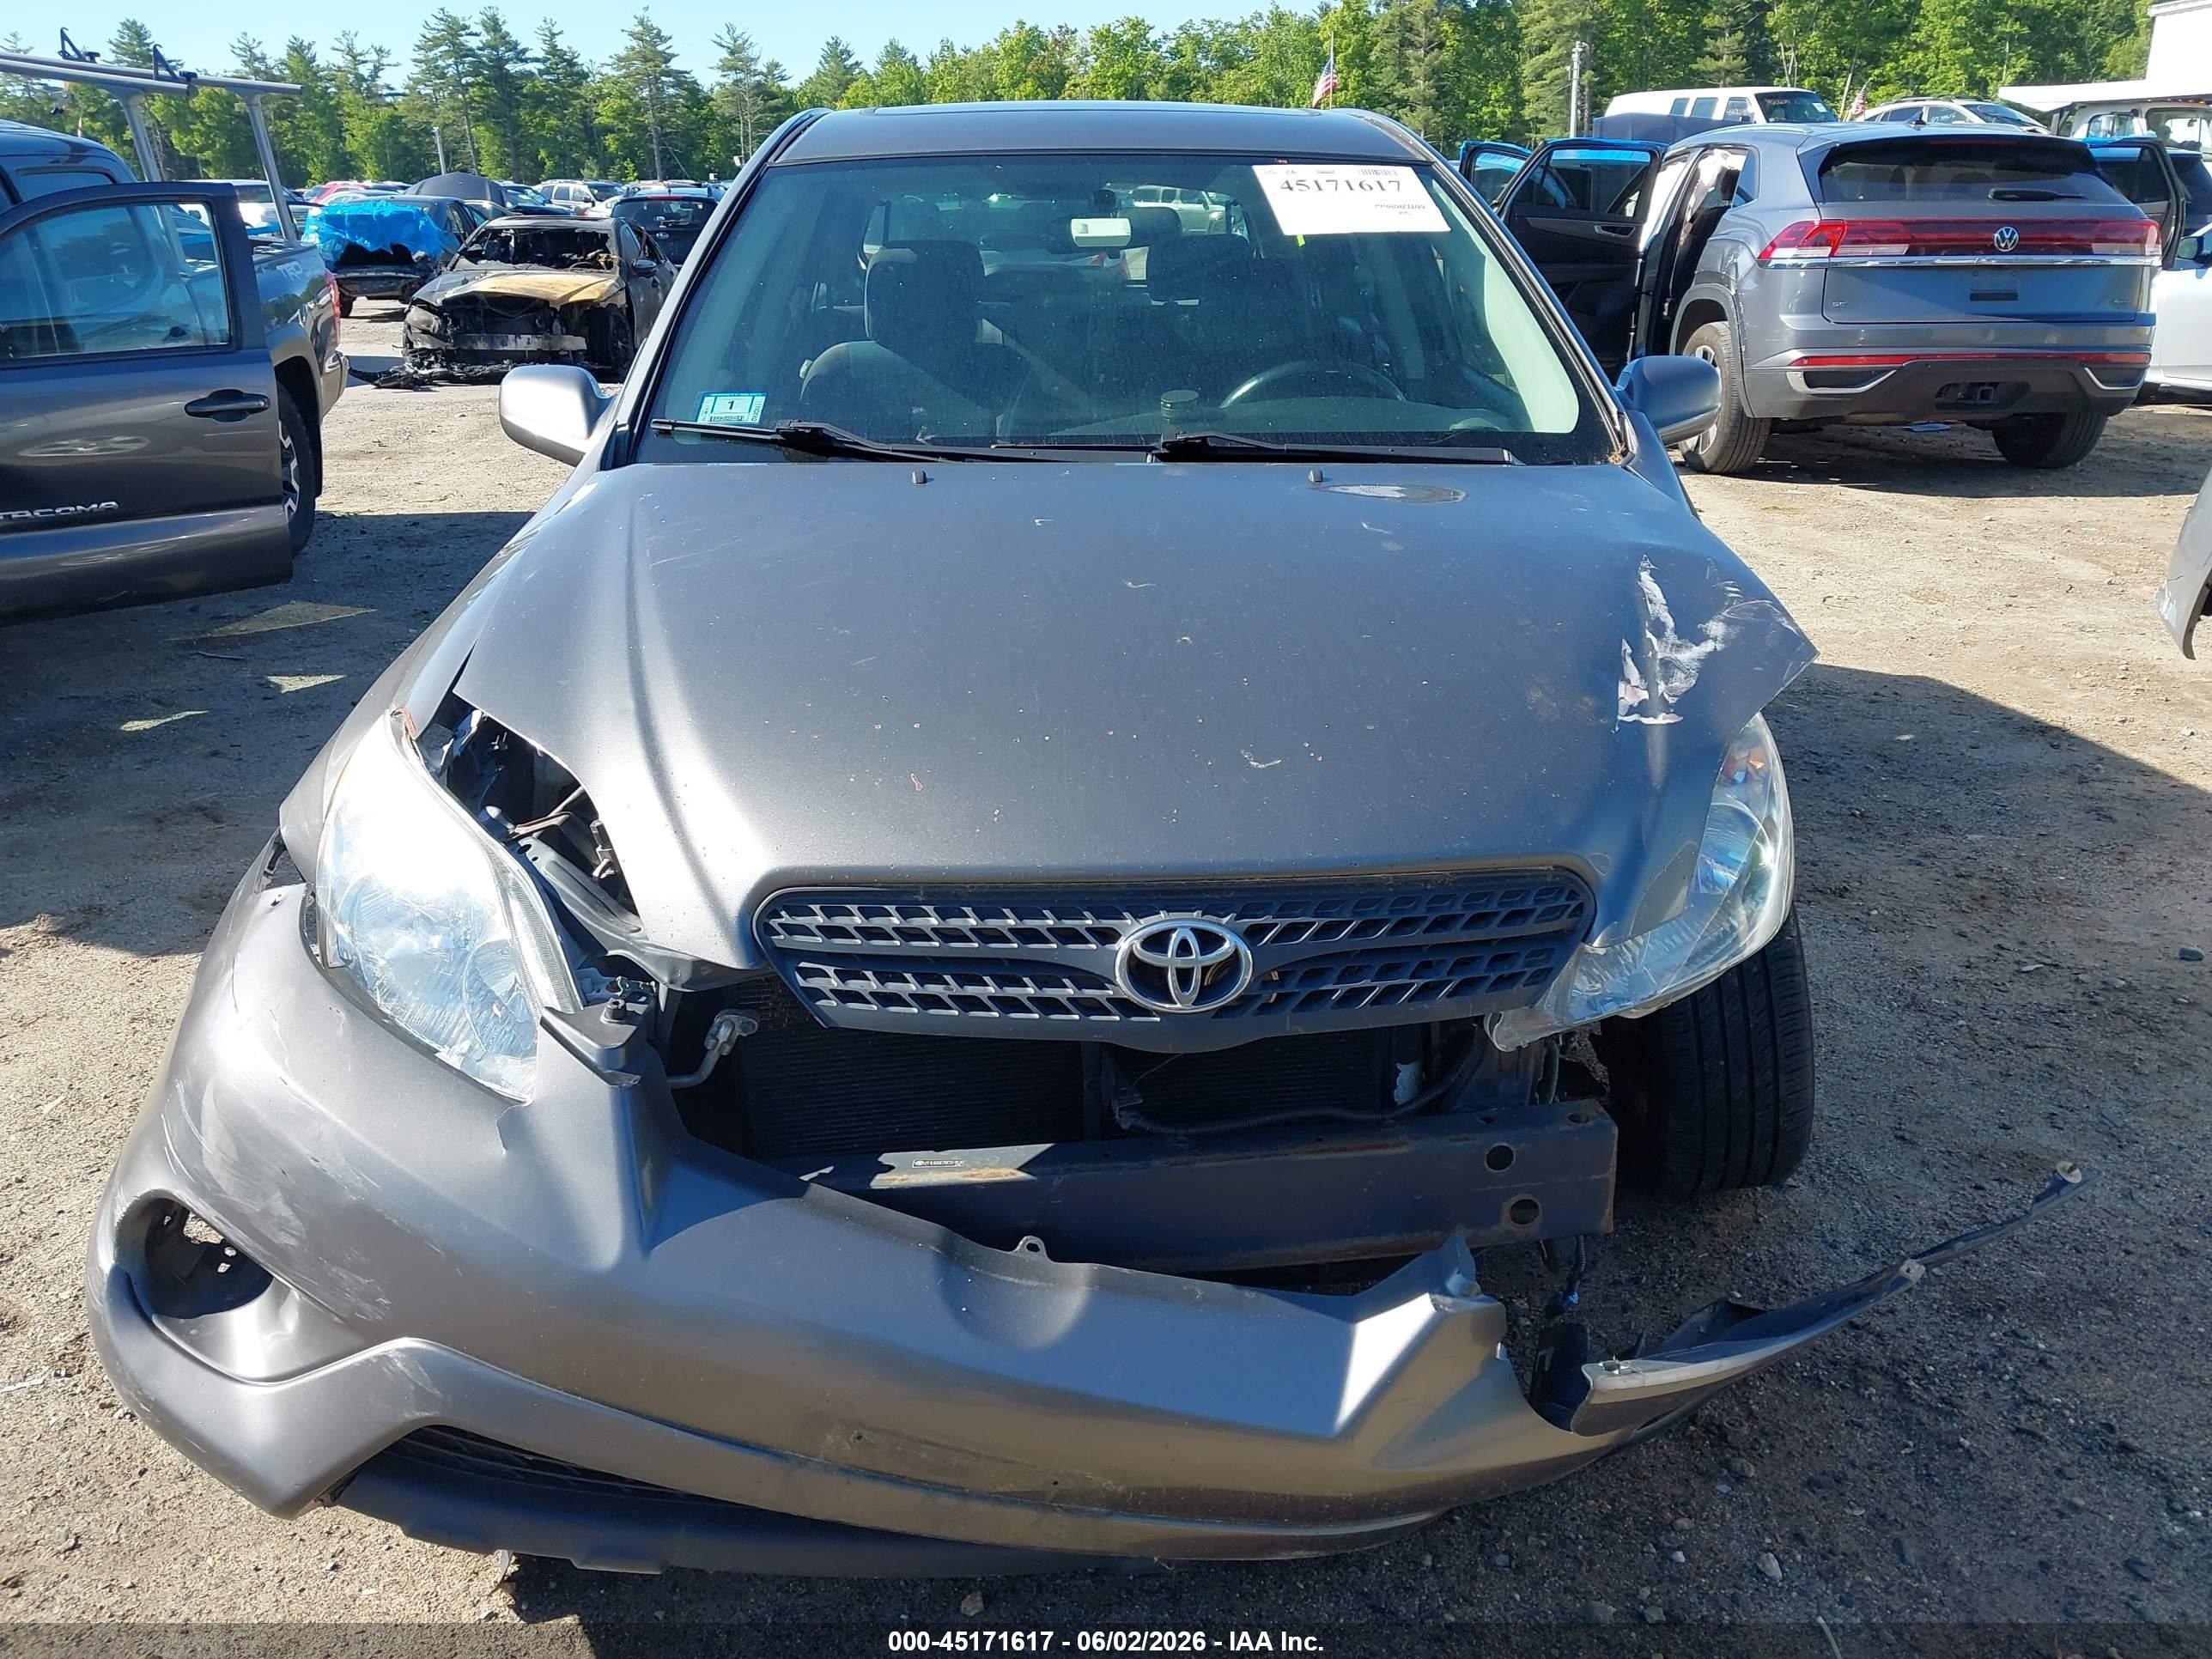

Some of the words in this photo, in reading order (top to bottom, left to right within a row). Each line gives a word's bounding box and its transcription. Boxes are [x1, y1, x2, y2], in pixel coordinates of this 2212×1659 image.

[1280, 179, 1401, 191] 45171617
[1994, 227, 2019, 252] VW
[276, 261, 303, 281] TRD
[728, 400, 734, 410] 1
